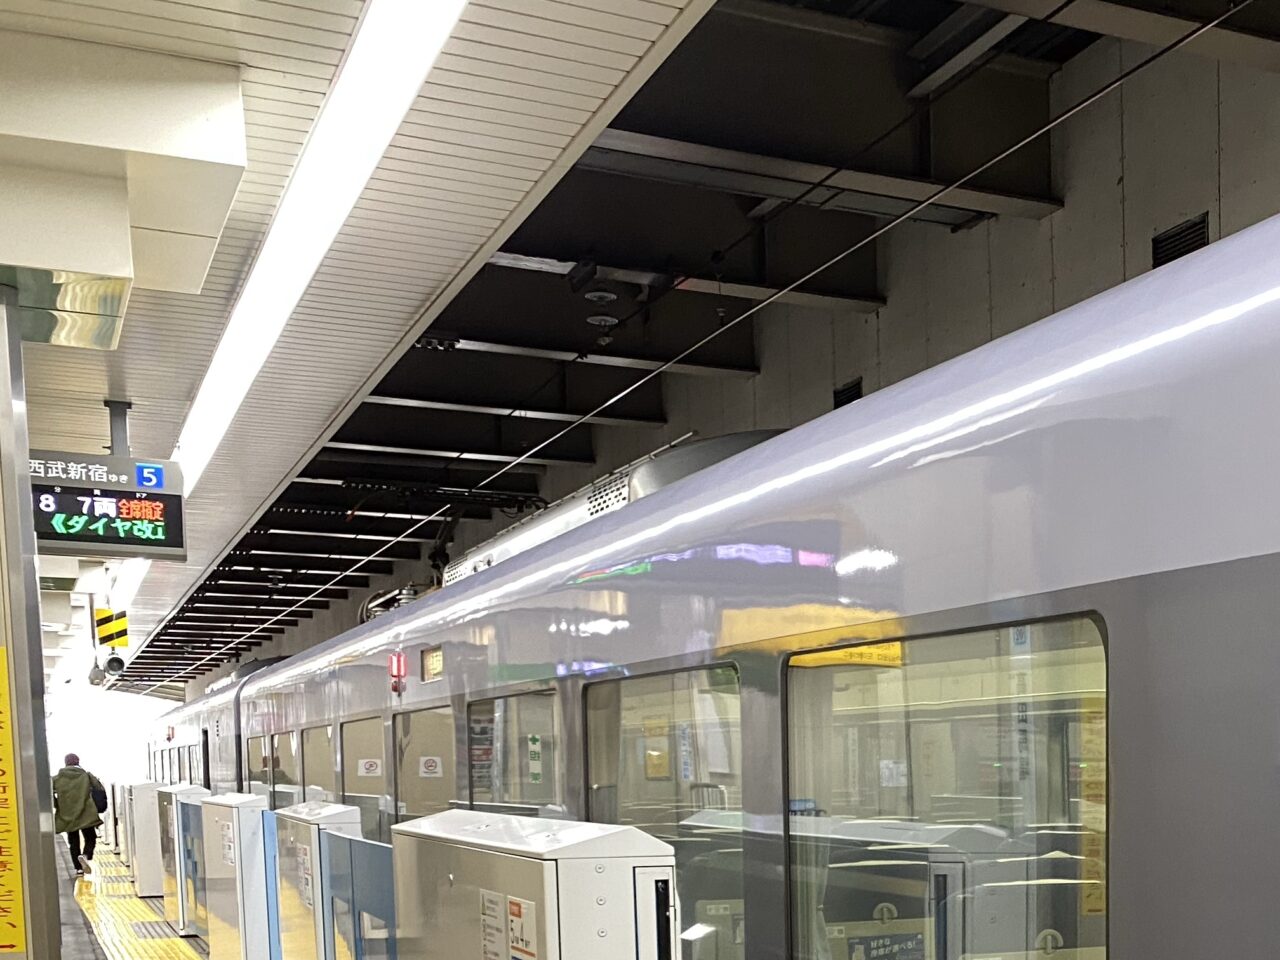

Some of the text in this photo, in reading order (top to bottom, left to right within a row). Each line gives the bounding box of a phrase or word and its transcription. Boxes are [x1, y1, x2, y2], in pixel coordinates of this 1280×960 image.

[30, 460, 128, 483] 西武新宿ゆき
[142, 468, 157, 486] 5
[39, 494, 56, 512] 8
[118, 499, 164, 521] 全席指定
